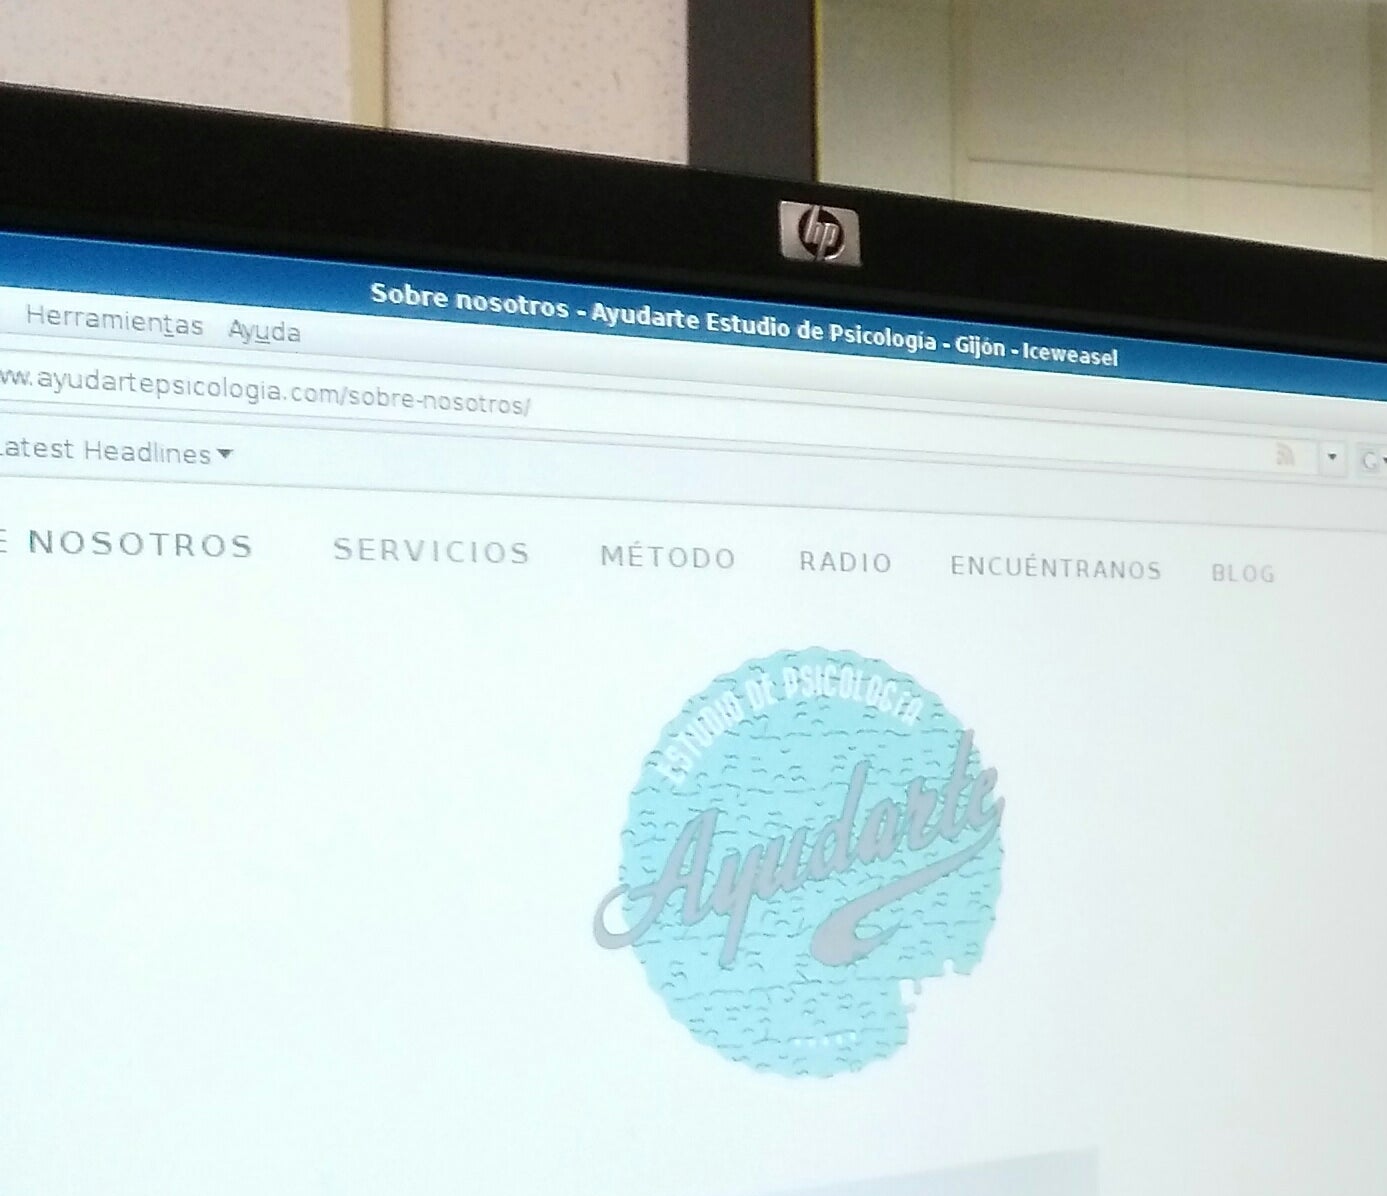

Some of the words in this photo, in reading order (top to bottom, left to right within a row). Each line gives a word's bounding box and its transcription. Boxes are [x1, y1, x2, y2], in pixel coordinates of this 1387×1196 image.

[804, 205, 839, 261] hp
[26, 304, 204, 338] Herramientas
[228, 318, 302, 345] Ayuda
[371, 282, 449, 309] Sobre
[456, 290, 569, 319] nosotros
[591, 301, 700, 328] Ayudarte
[707, 312, 790, 338] Estudio
[798, 319, 824, 341] de
[829, 323, 937, 353] Psicología
[955, 333, 1006, 360] Gijón
[1022, 342, 1119, 367] Iceweasel
[84, 440, 212, 466] Headlines
[29, 528, 253, 559] NOSOTROS
[333, 537, 531, 565] SERVICIOS
[600, 541, 736, 571] MÉTODO
[799, 550, 892, 574] RADIO
[951, 552, 1163, 581] ENCUÉNTRANOS
[1212, 563, 1276, 584] BLOG
[745, 672, 778, 713] DE
[593, 729, 1005, 969] Ayudarte
